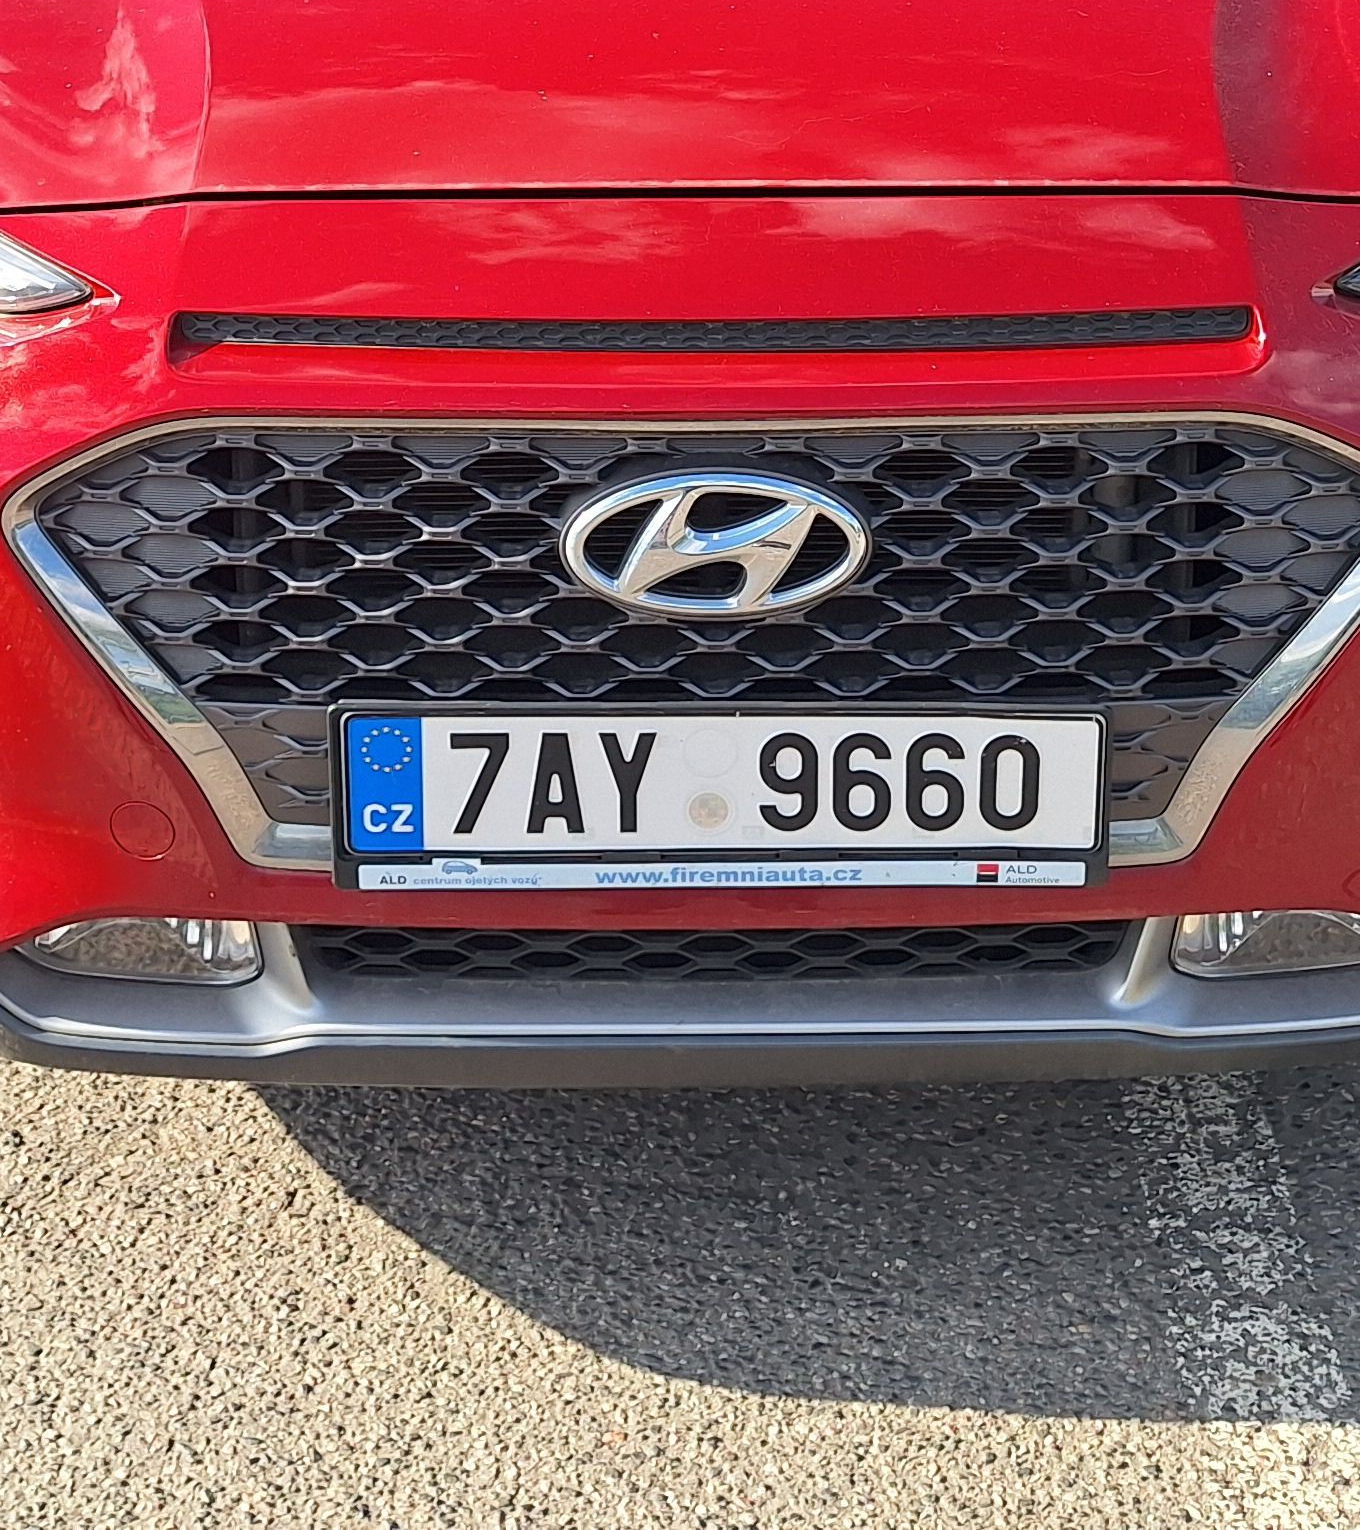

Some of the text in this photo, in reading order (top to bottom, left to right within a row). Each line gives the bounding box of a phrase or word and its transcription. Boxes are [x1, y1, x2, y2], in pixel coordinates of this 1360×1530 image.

[449, 732, 1041, 835] 7AY 9660
[363, 803, 414, 833] CZ
[595, 866, 863, 884] www.firemniauta.cz
[1005, 864, 1038, 875] ALD
[380, 875, 407, 885] ALD
[413, 875, 463, 885] centrum
[1005, 876, 1060, 885] Automotive
